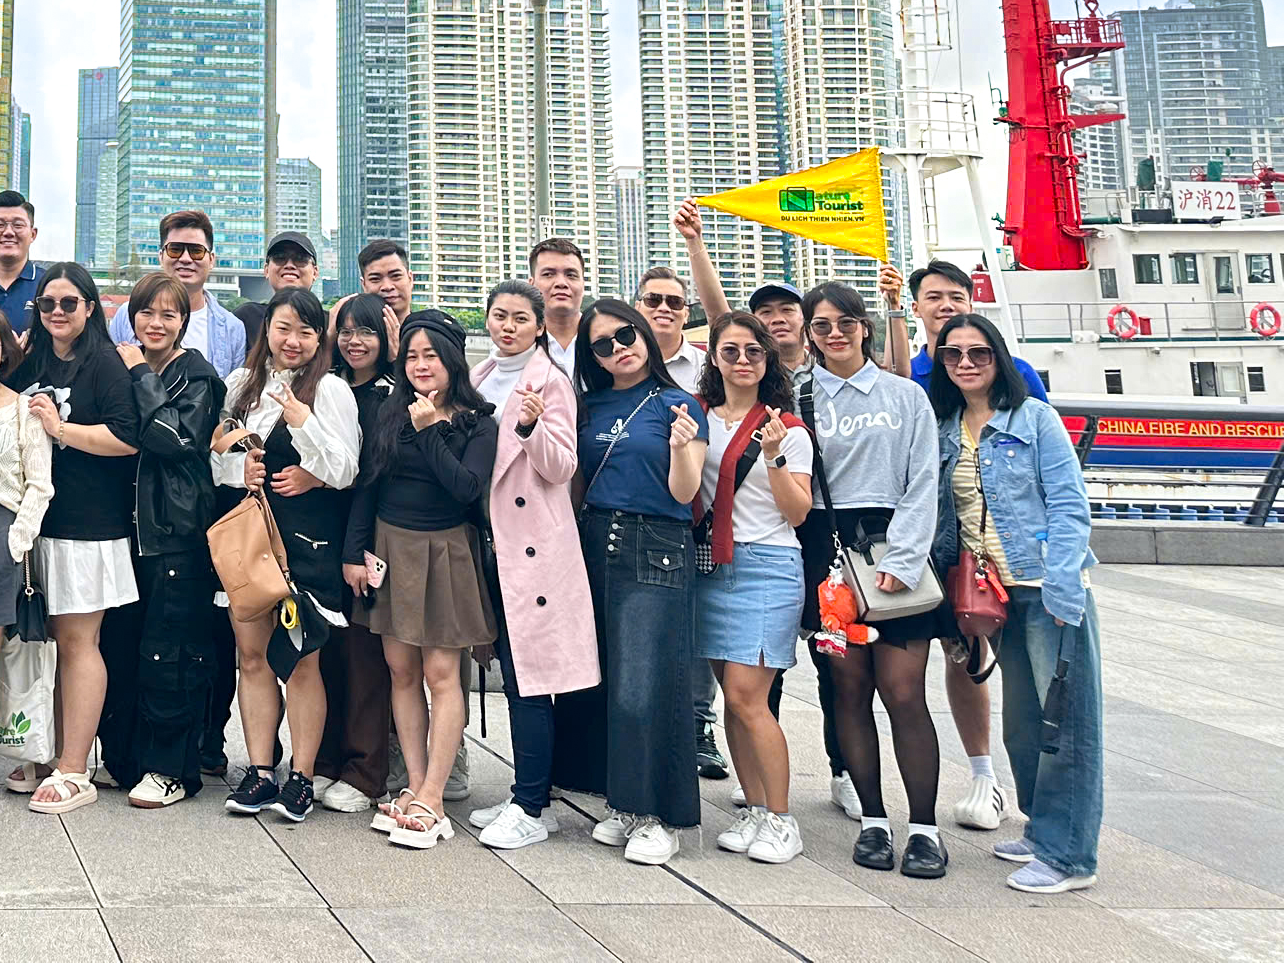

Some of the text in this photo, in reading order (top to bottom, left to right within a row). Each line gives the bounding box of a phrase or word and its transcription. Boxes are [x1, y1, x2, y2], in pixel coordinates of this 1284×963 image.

[815, 200, 864, 211] Tourist
[1178, 188, 1236, 211] 沪消22
[1097, 420, 1146, 435] CHINA
[1149, 422, 1185, 436] FIRE
[1189, 423, 1221, 437] AND
